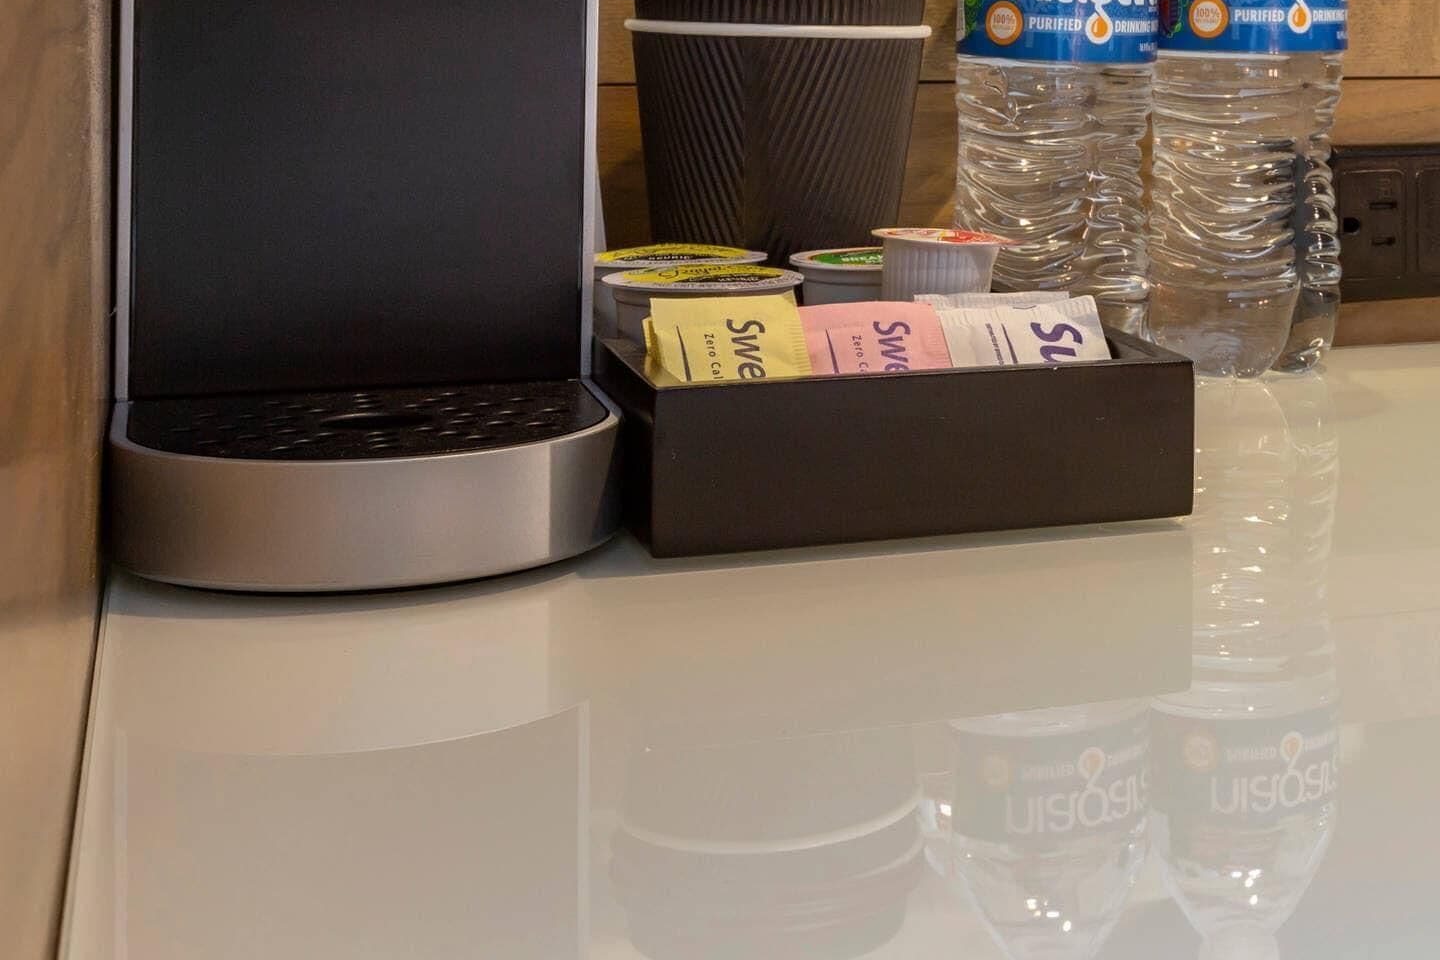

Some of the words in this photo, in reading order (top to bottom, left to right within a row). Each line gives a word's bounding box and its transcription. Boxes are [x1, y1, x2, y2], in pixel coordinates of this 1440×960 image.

[1029, 16, 1083, 32] PURIFIED
[1234, 9, 1285, 22] PURIFIED
[703, 333, 718, 360] Zero
[726, 318, 767, 380] Swe
[851, 335, 864, 358] Zero
